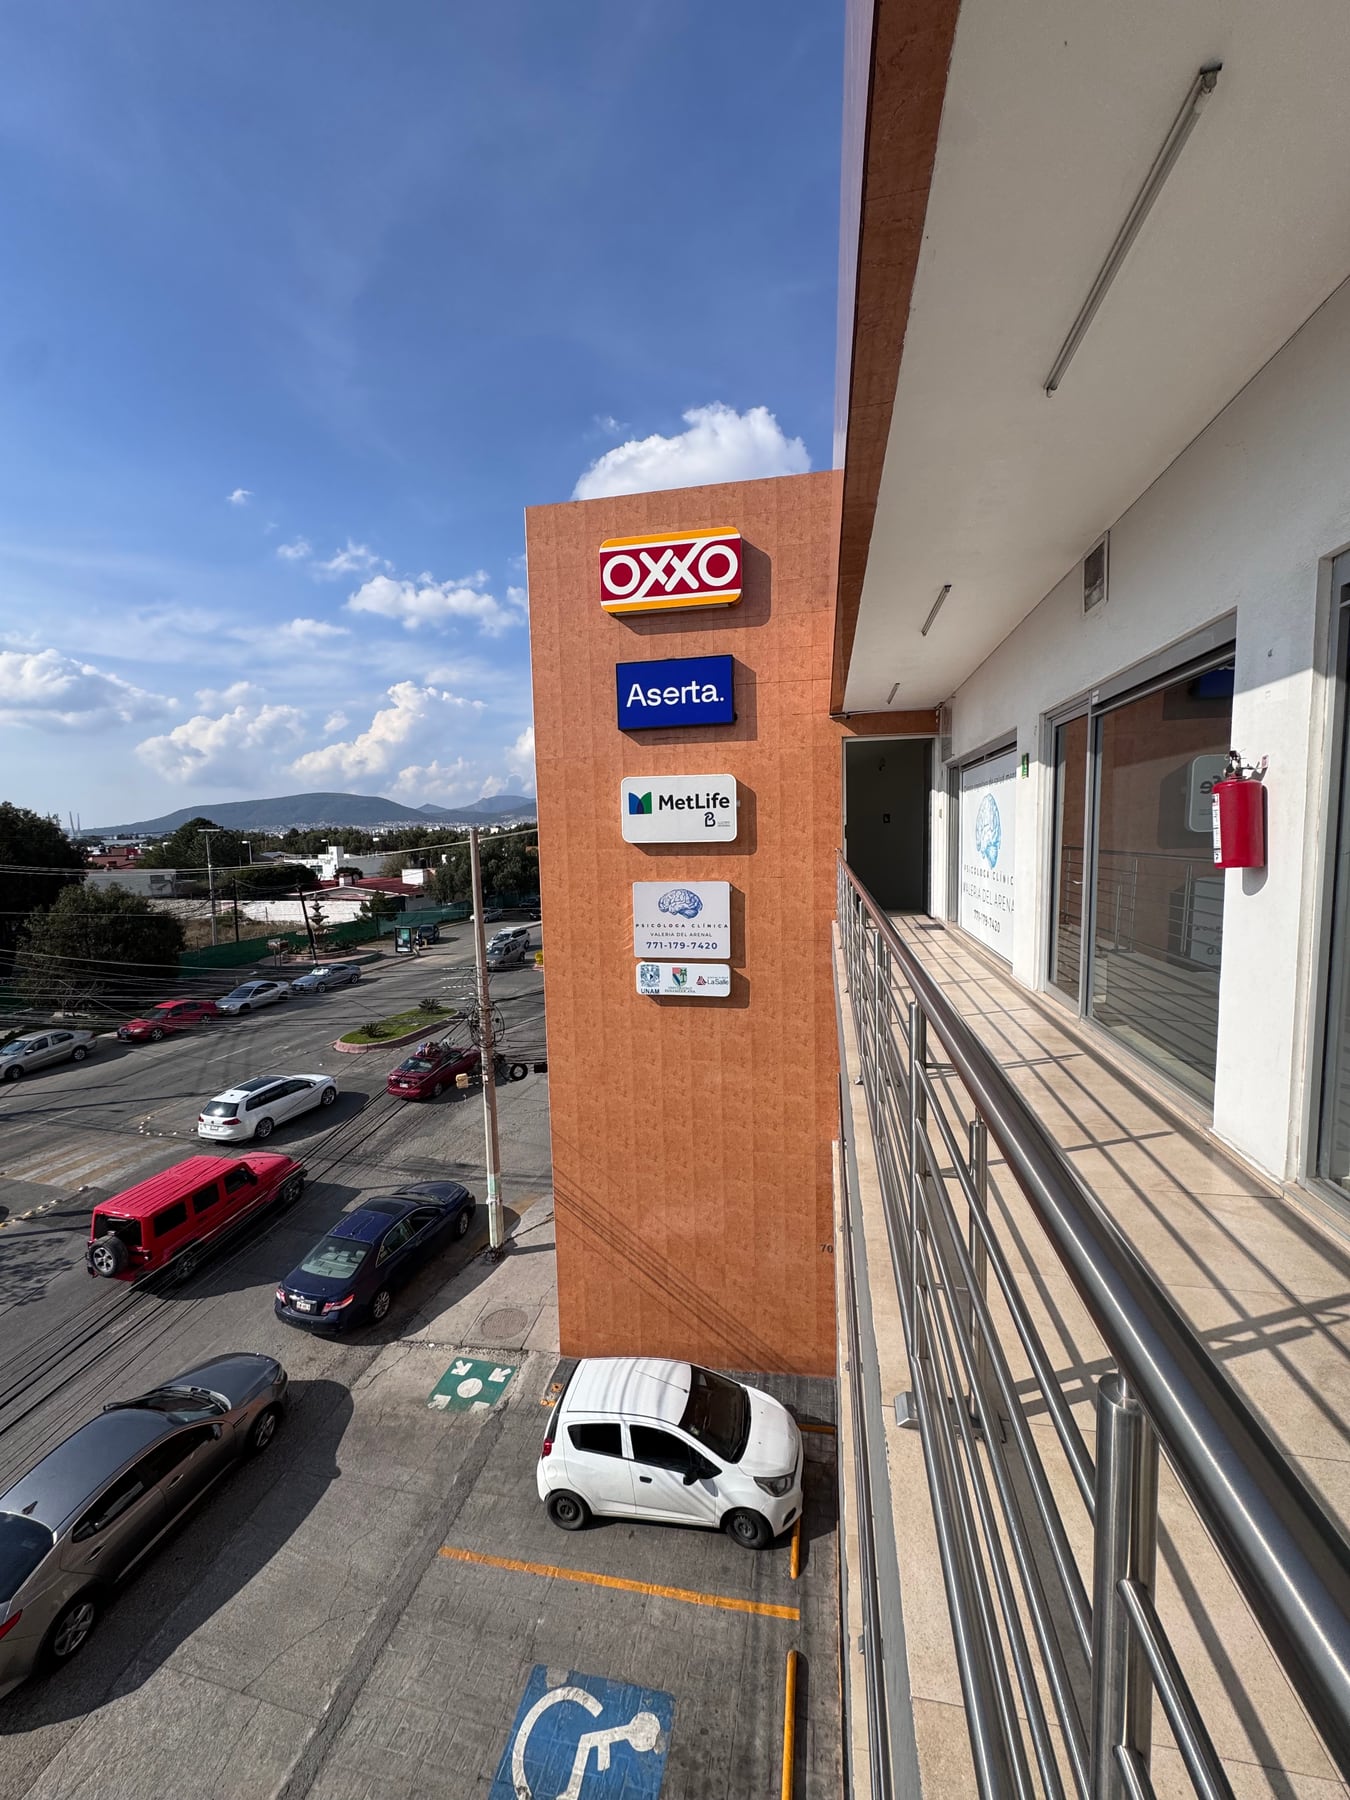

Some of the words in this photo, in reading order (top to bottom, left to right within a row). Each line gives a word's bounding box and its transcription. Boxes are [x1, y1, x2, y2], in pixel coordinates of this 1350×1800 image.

[602, 542, 739, 598] OXXO
[658, 792, 730, 811] MetLife
[994, 892, 1015, 913] ARENA
[646, 941, 718, 950] 771-179-7420
